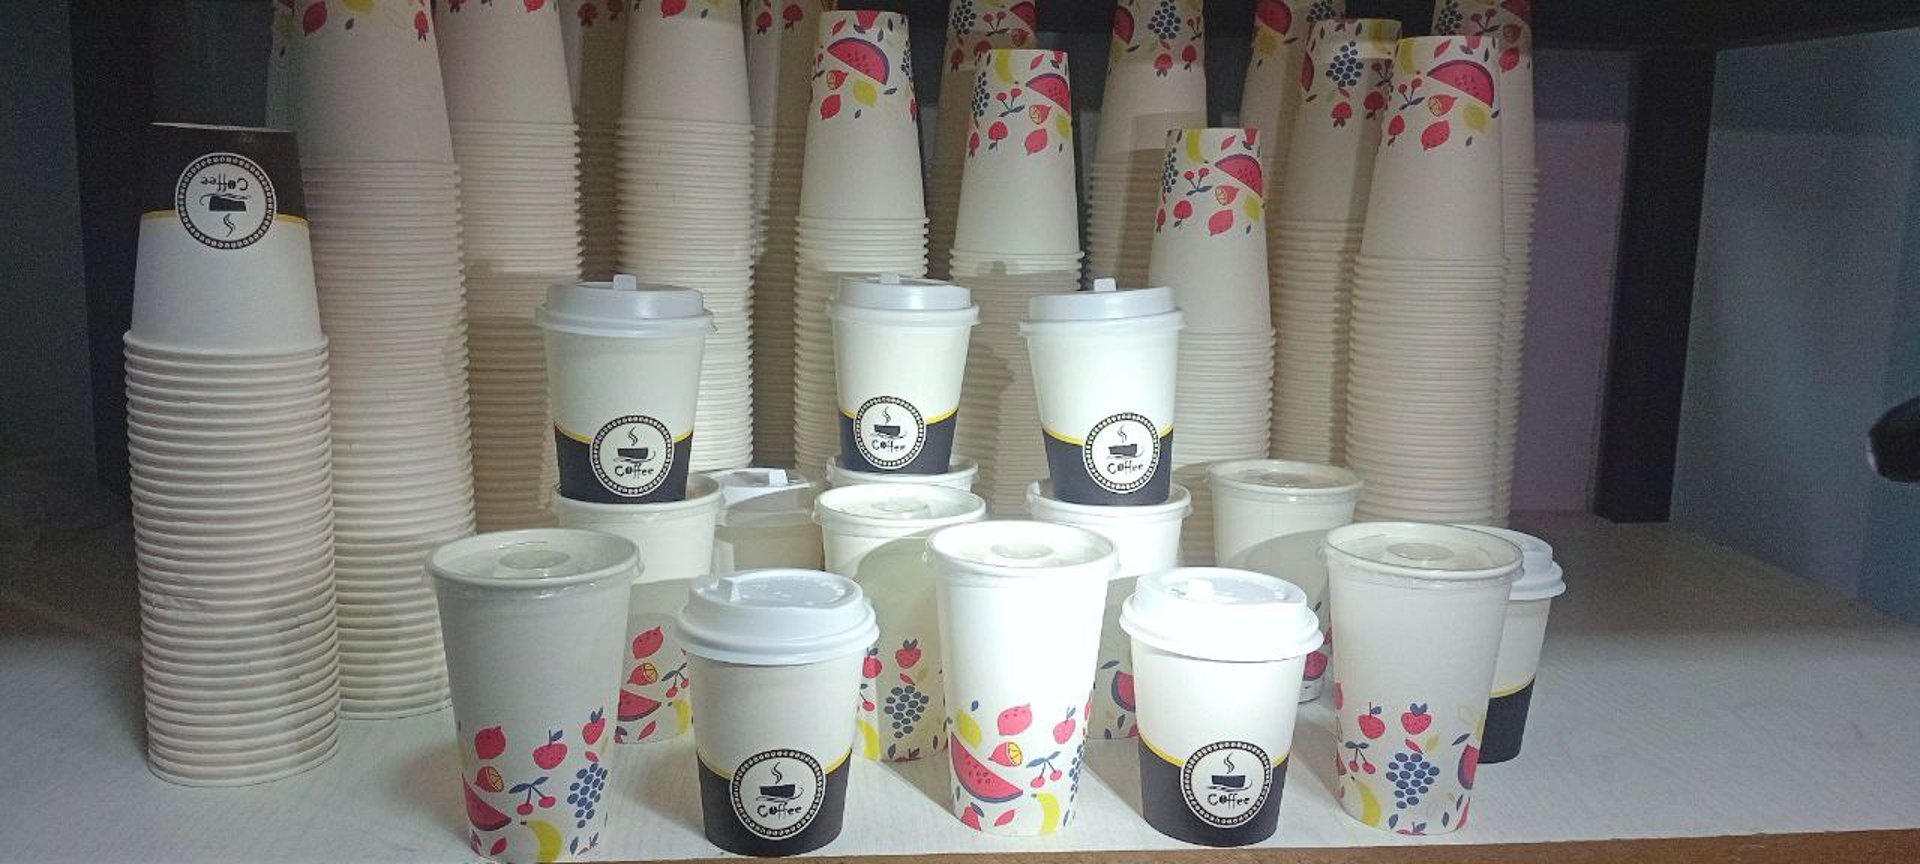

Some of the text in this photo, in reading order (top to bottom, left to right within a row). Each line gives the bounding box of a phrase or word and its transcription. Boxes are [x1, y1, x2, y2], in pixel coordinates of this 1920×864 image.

[201, 173, 248, 191] Coffee
[614, 462, 655, 479] Coffee
[1106, 460, 1144, 475] Coffee
[1207, 792, 1251, 808] Coffee
[757, 802, 802, 820] Coffee
